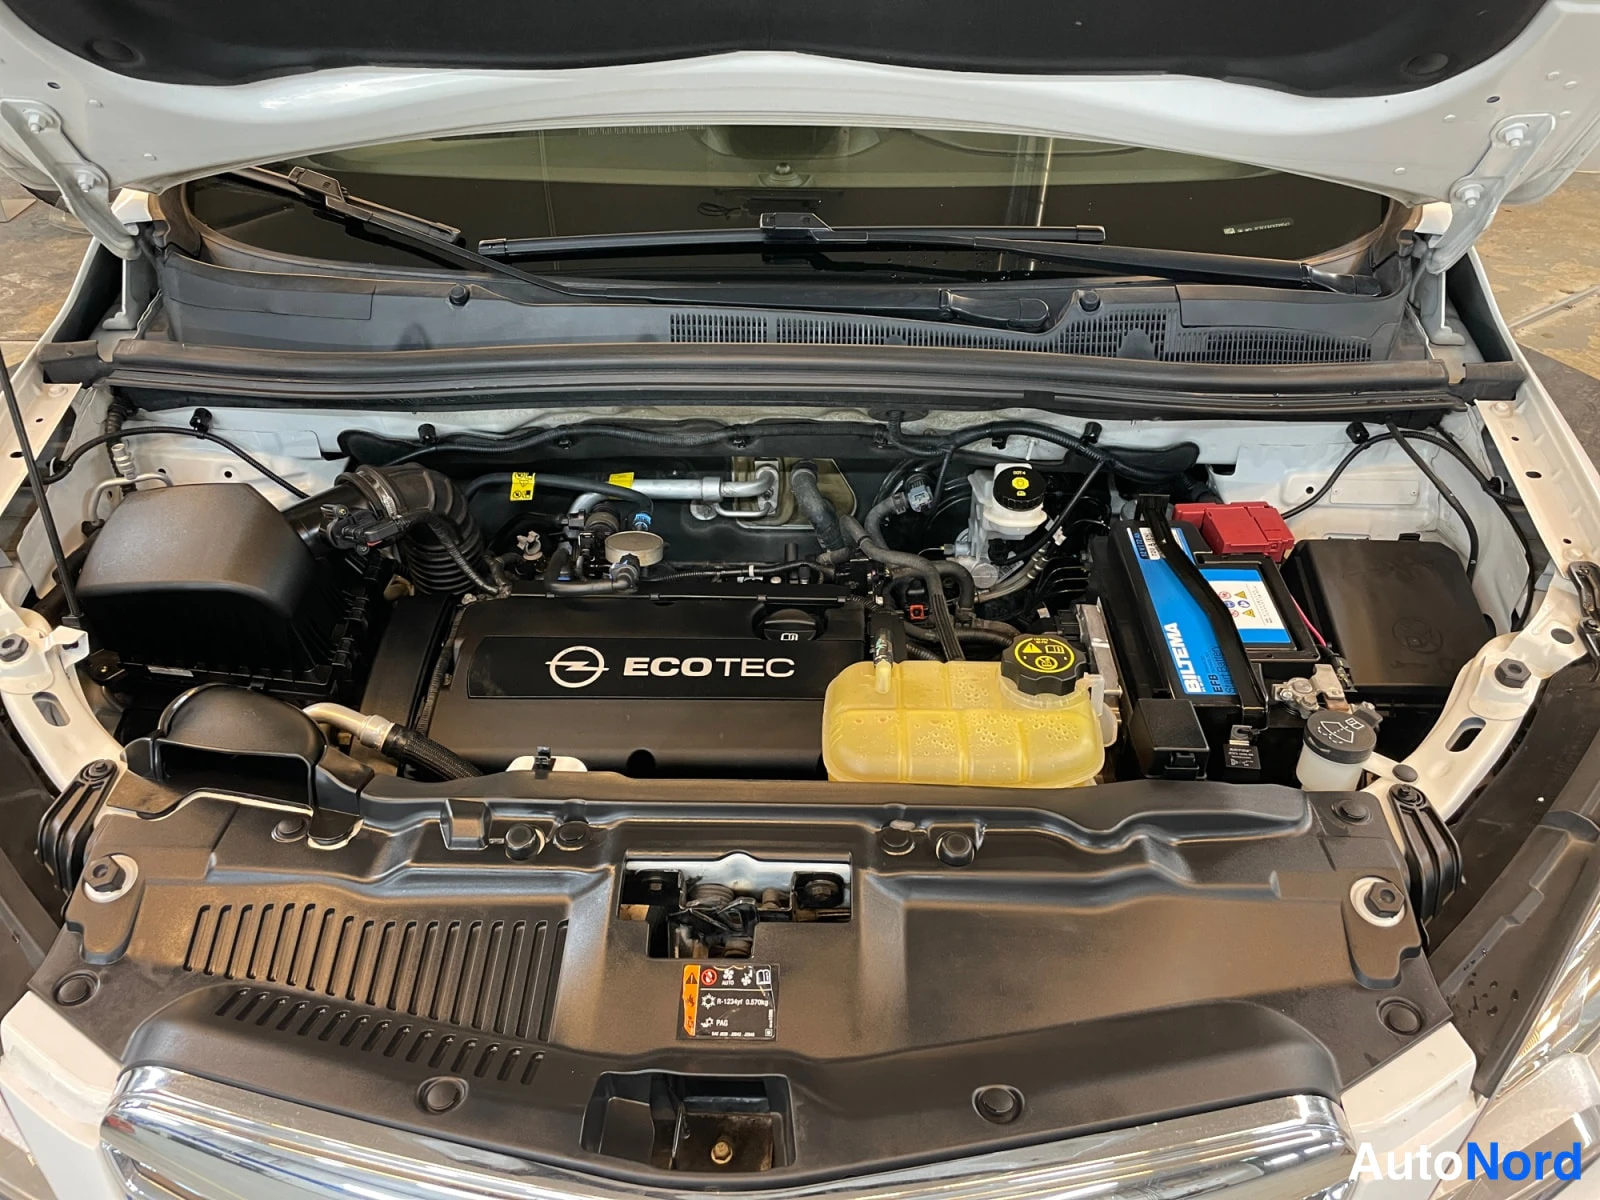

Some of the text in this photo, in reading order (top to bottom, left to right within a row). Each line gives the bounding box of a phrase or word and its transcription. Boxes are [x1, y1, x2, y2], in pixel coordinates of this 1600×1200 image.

[623, 656, 796, 678] ECOTEC
[1164, 622, 1202, 693] BILTEMA
[1210, 645, 1236, 694] Start Battery
[1208, 674, 1223, 693] EFB
[716, 997, 769, 1008] R-1234yf 0.570kg
[716, 1019, 729, 1027] PAG
